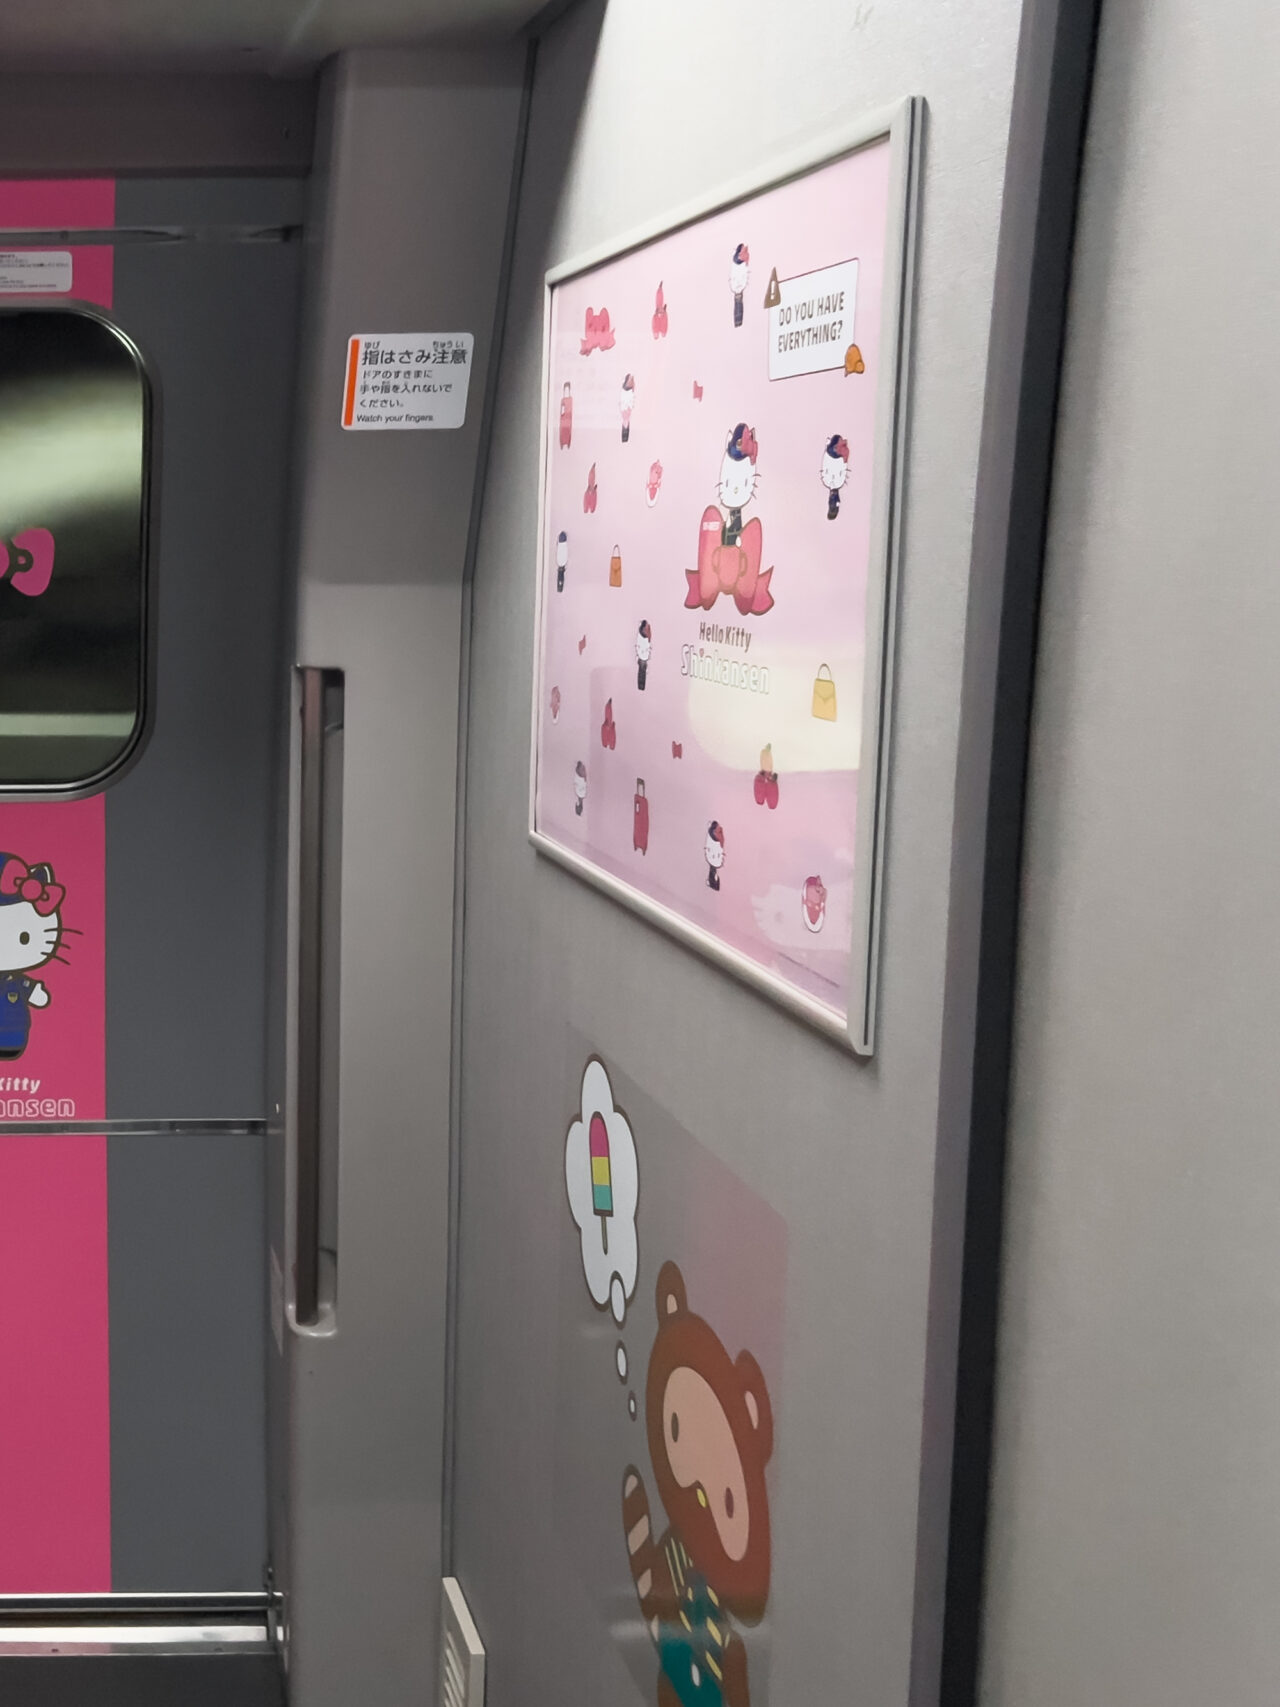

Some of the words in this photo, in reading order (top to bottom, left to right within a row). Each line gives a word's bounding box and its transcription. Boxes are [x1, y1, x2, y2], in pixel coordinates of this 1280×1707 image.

[779, 306, 791, 326] DO
[795, 299, 814, 321] YOU
[817, 291, 845, 317] HAVE
[778, 319, 843, 353] EVERYTHING?
[361, 348, 468, 366] 指はさみ注意
[363, 370, 433, 379] ドアのすきまに
[360, 383, 453, 395] 手や指を入れないで
[356, 414, 382, 423] Watch
[384, 415, 403, 424] your
[699, 621, 724, 644] Hello
[725, 625, 752, 653] Kitty
[681, 643, 769, 695] Shinkansen
